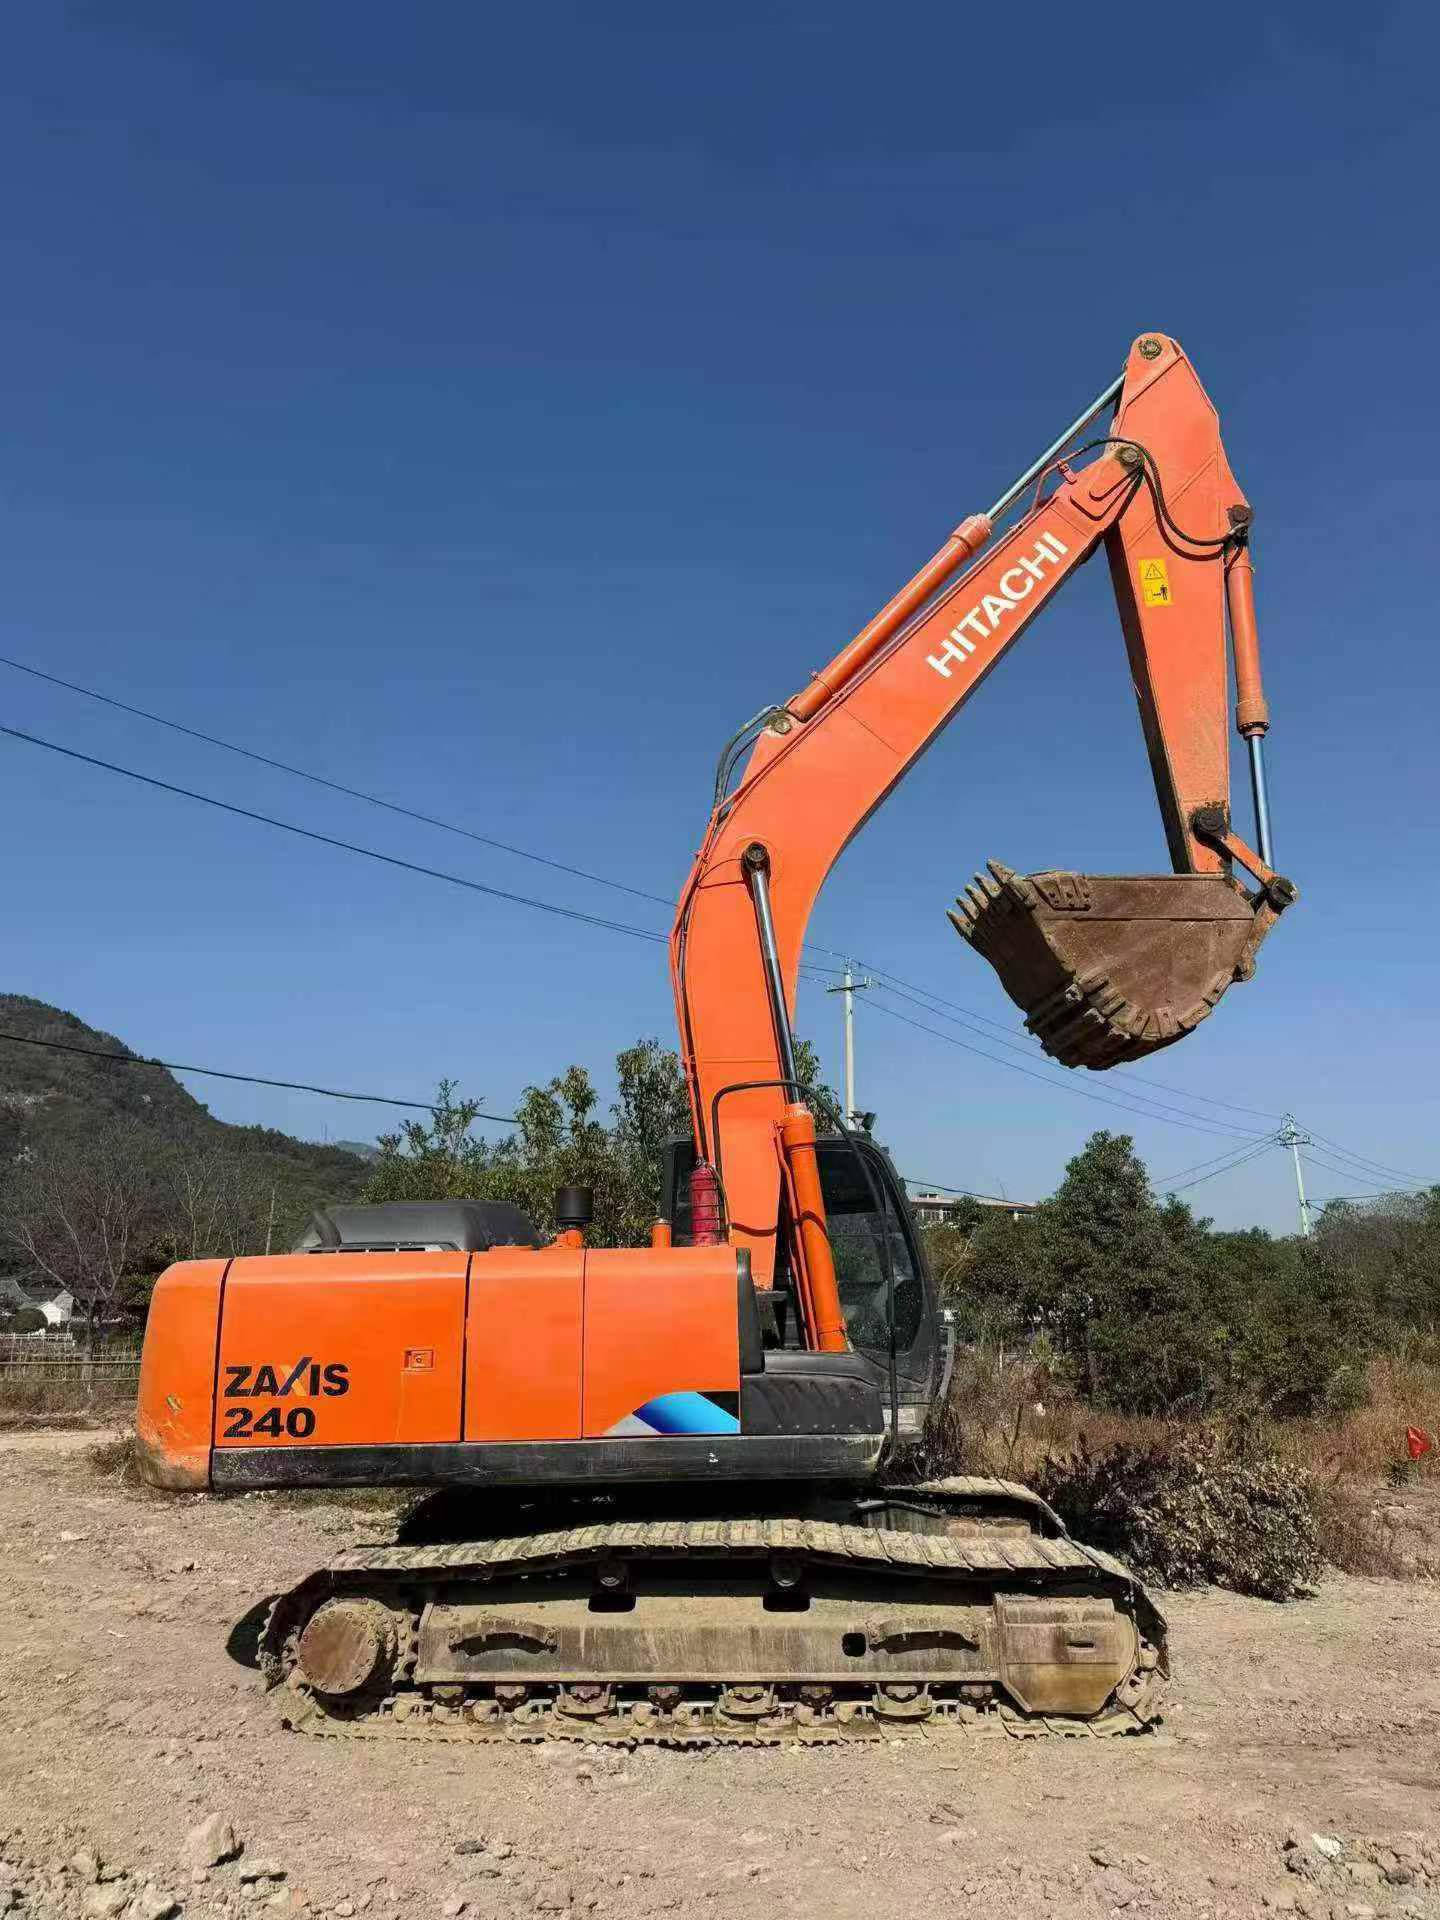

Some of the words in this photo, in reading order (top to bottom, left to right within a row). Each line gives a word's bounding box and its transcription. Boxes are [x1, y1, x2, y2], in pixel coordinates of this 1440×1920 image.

[926, 531, 1069, 678] HITACHI
[224, 1357, 349, 1398] ZAXIS
[223, 1407, 315, 1438] 240
